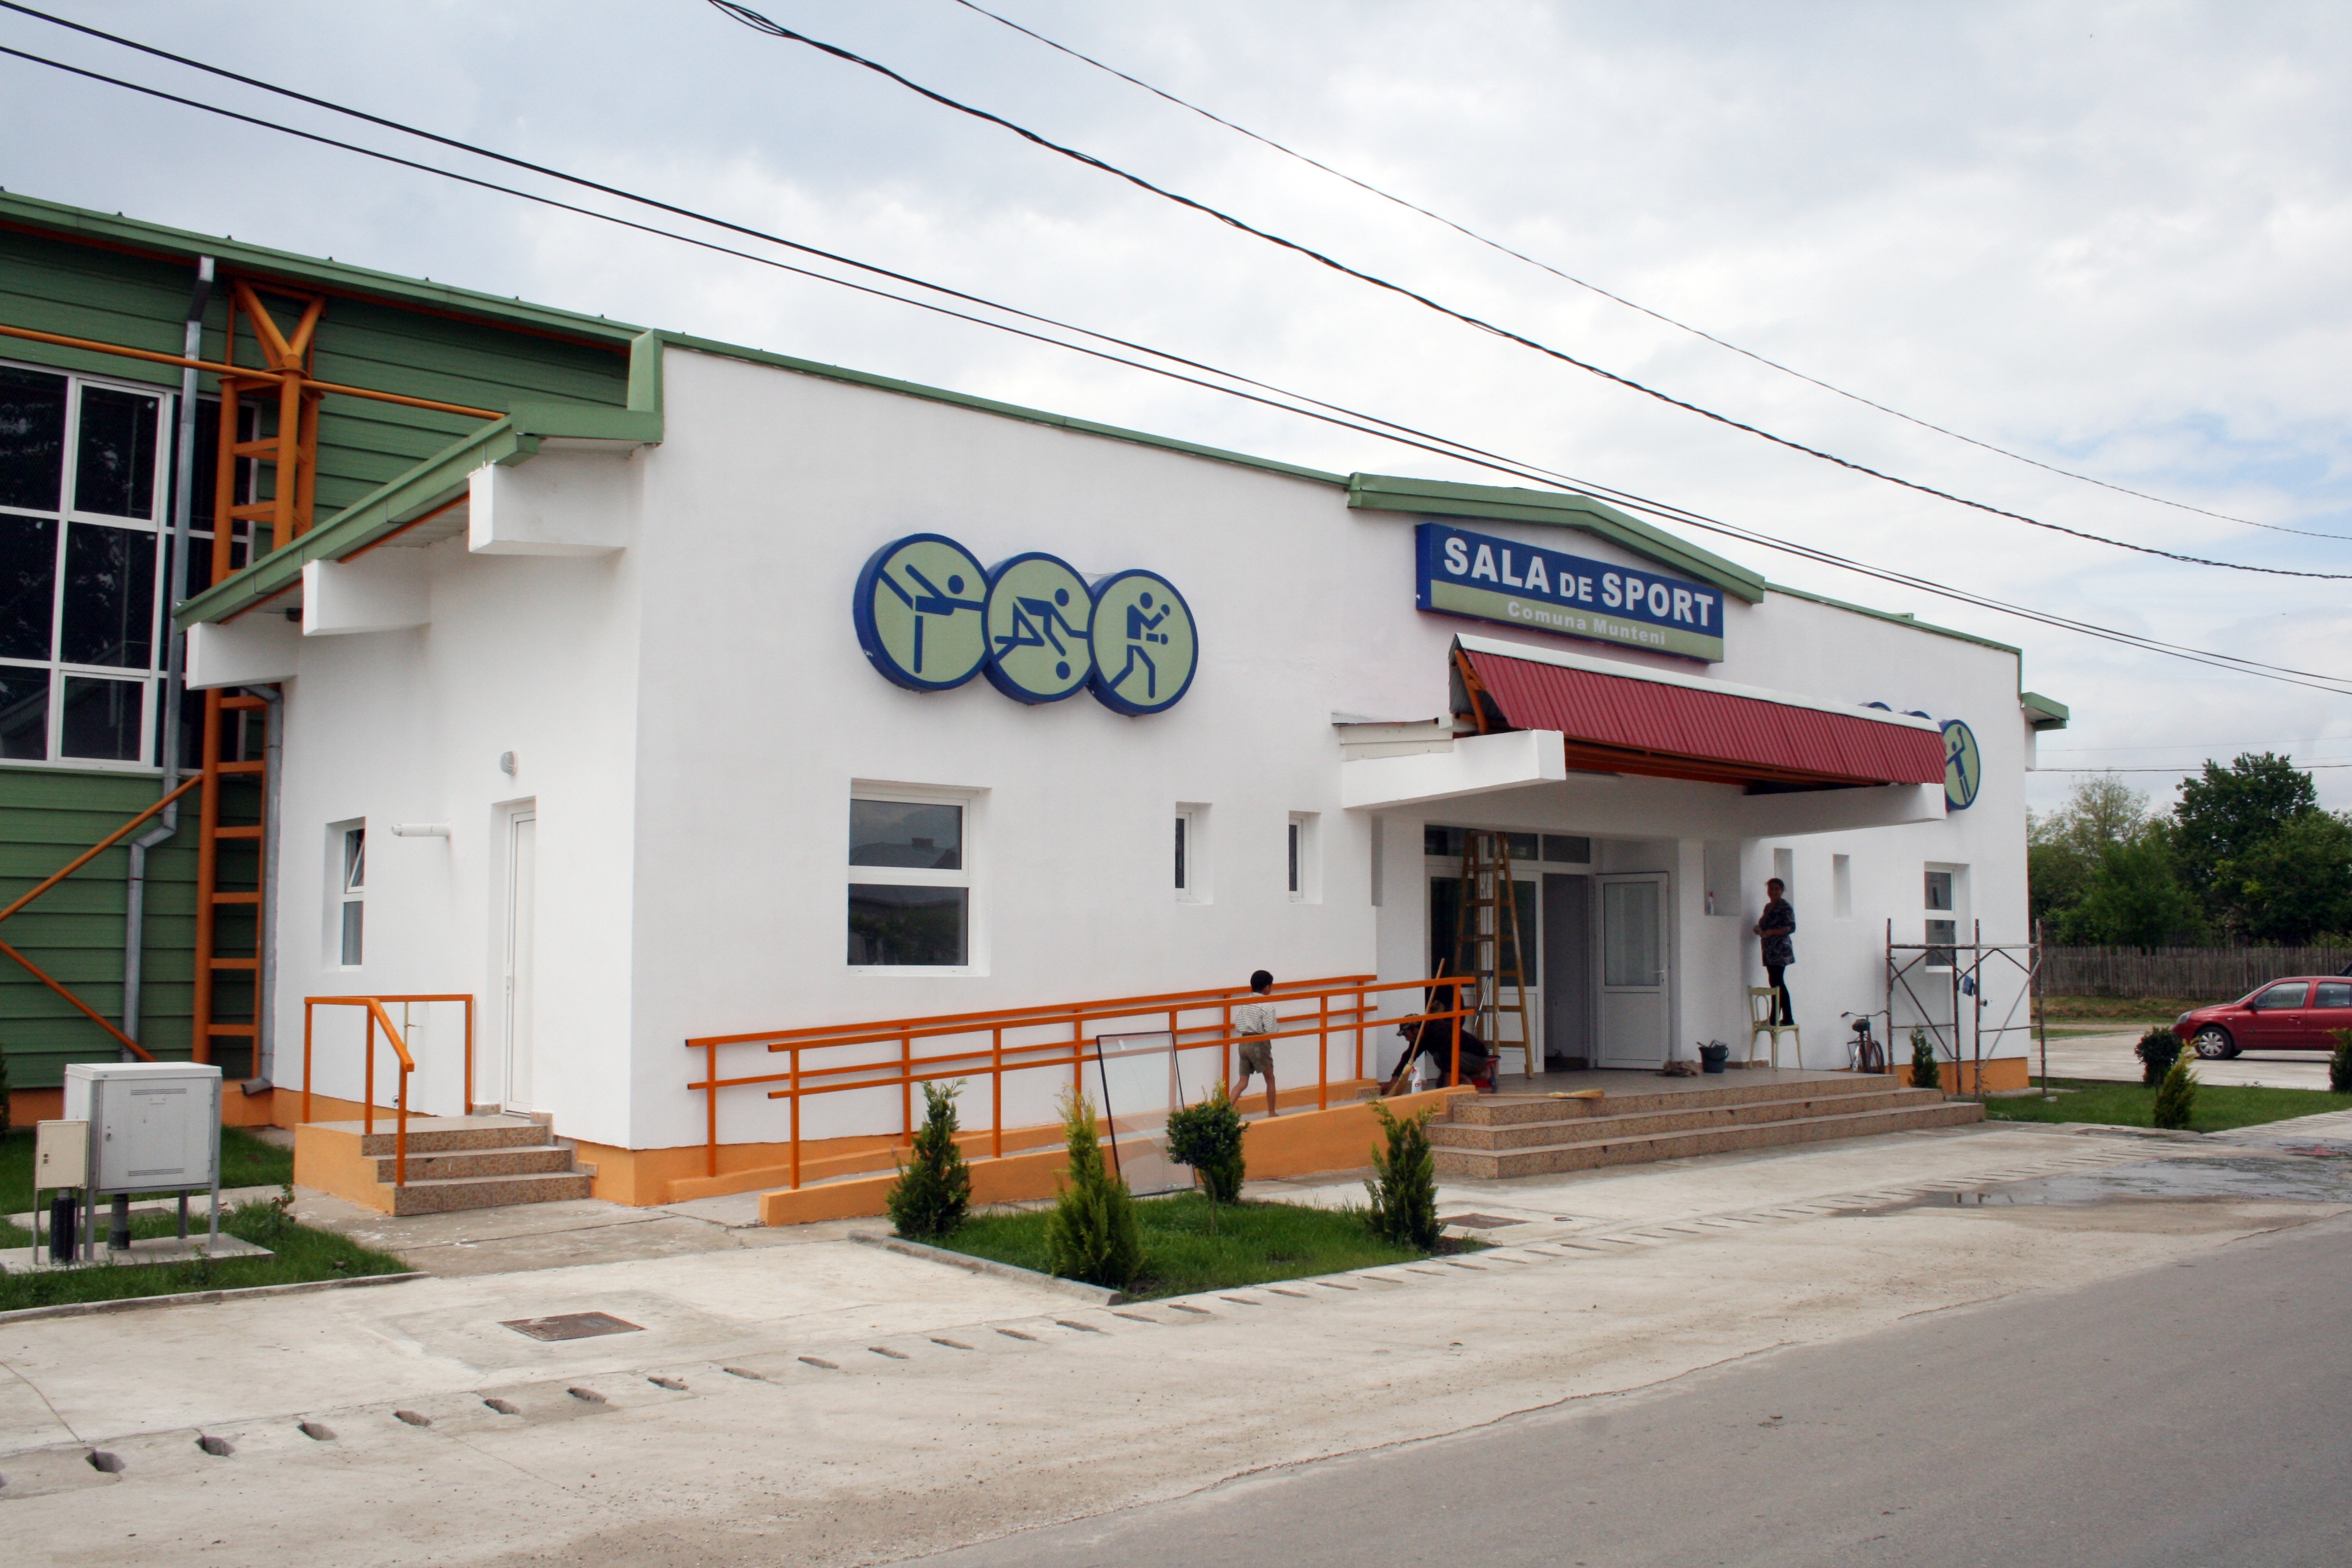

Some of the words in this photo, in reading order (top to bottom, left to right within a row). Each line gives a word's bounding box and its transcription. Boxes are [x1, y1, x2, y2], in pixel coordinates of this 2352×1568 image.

[1444, 537, 1550, 593] SALA
[1560, 572, 1593, 603] DE
[1602, 573, 1714, 627] SPORT
[1507, 601, 1586, 630] Comuna
[1593, 618, 1665, 645] Munteni
